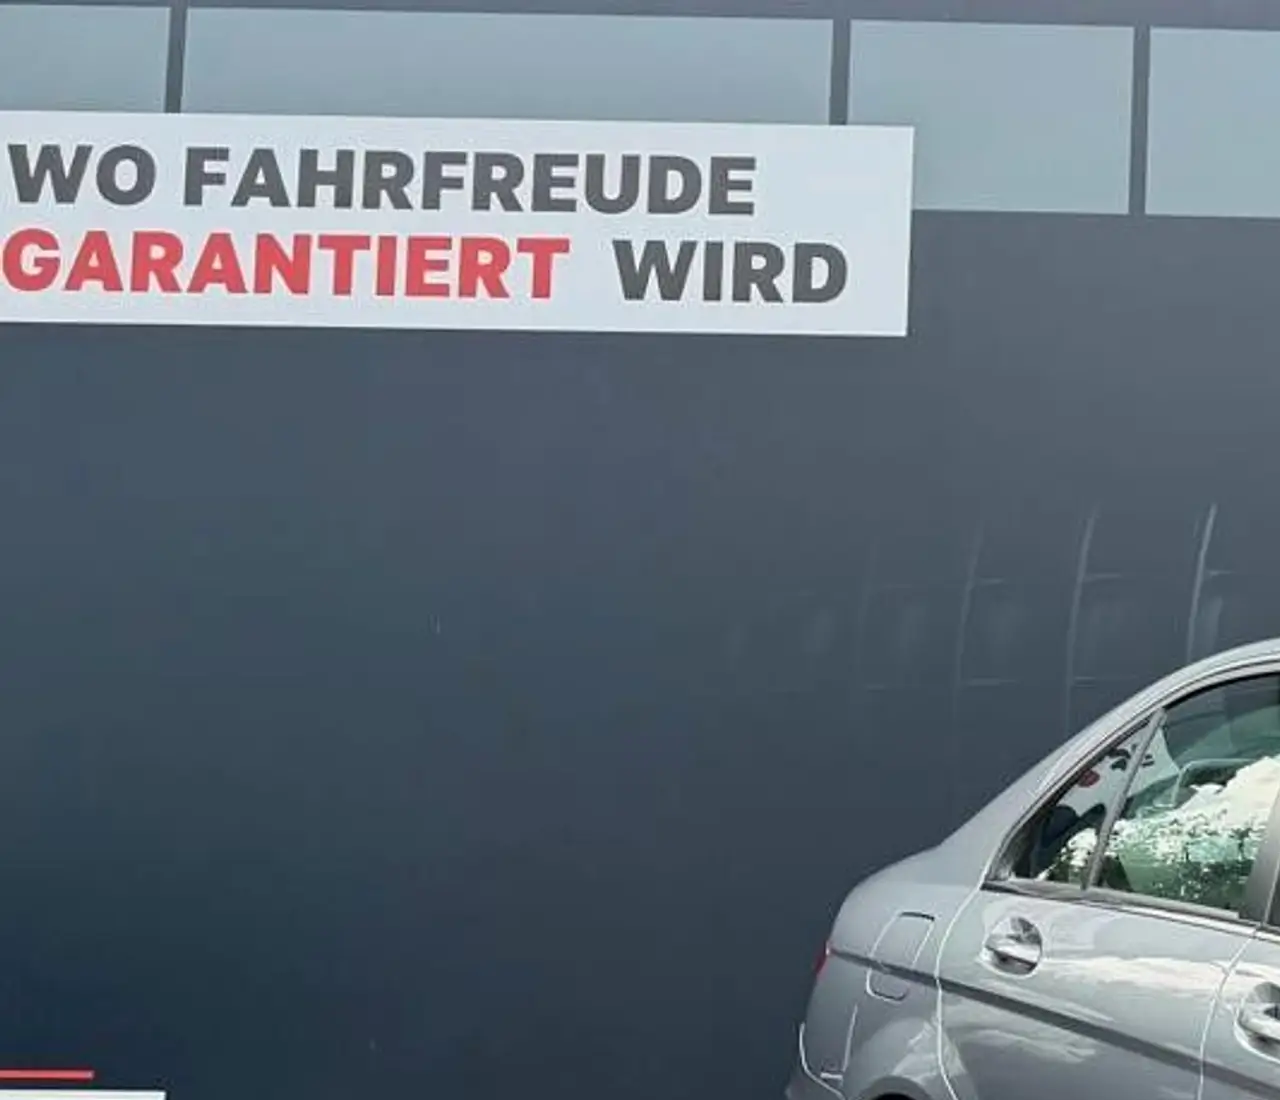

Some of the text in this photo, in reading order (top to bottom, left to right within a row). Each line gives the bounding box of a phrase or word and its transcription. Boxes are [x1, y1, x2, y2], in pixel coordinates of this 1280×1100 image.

[7, 143, 758, 216] WO FAHRFREUDE
[1, 228, 849, 305] GARANTIERT WIRD
